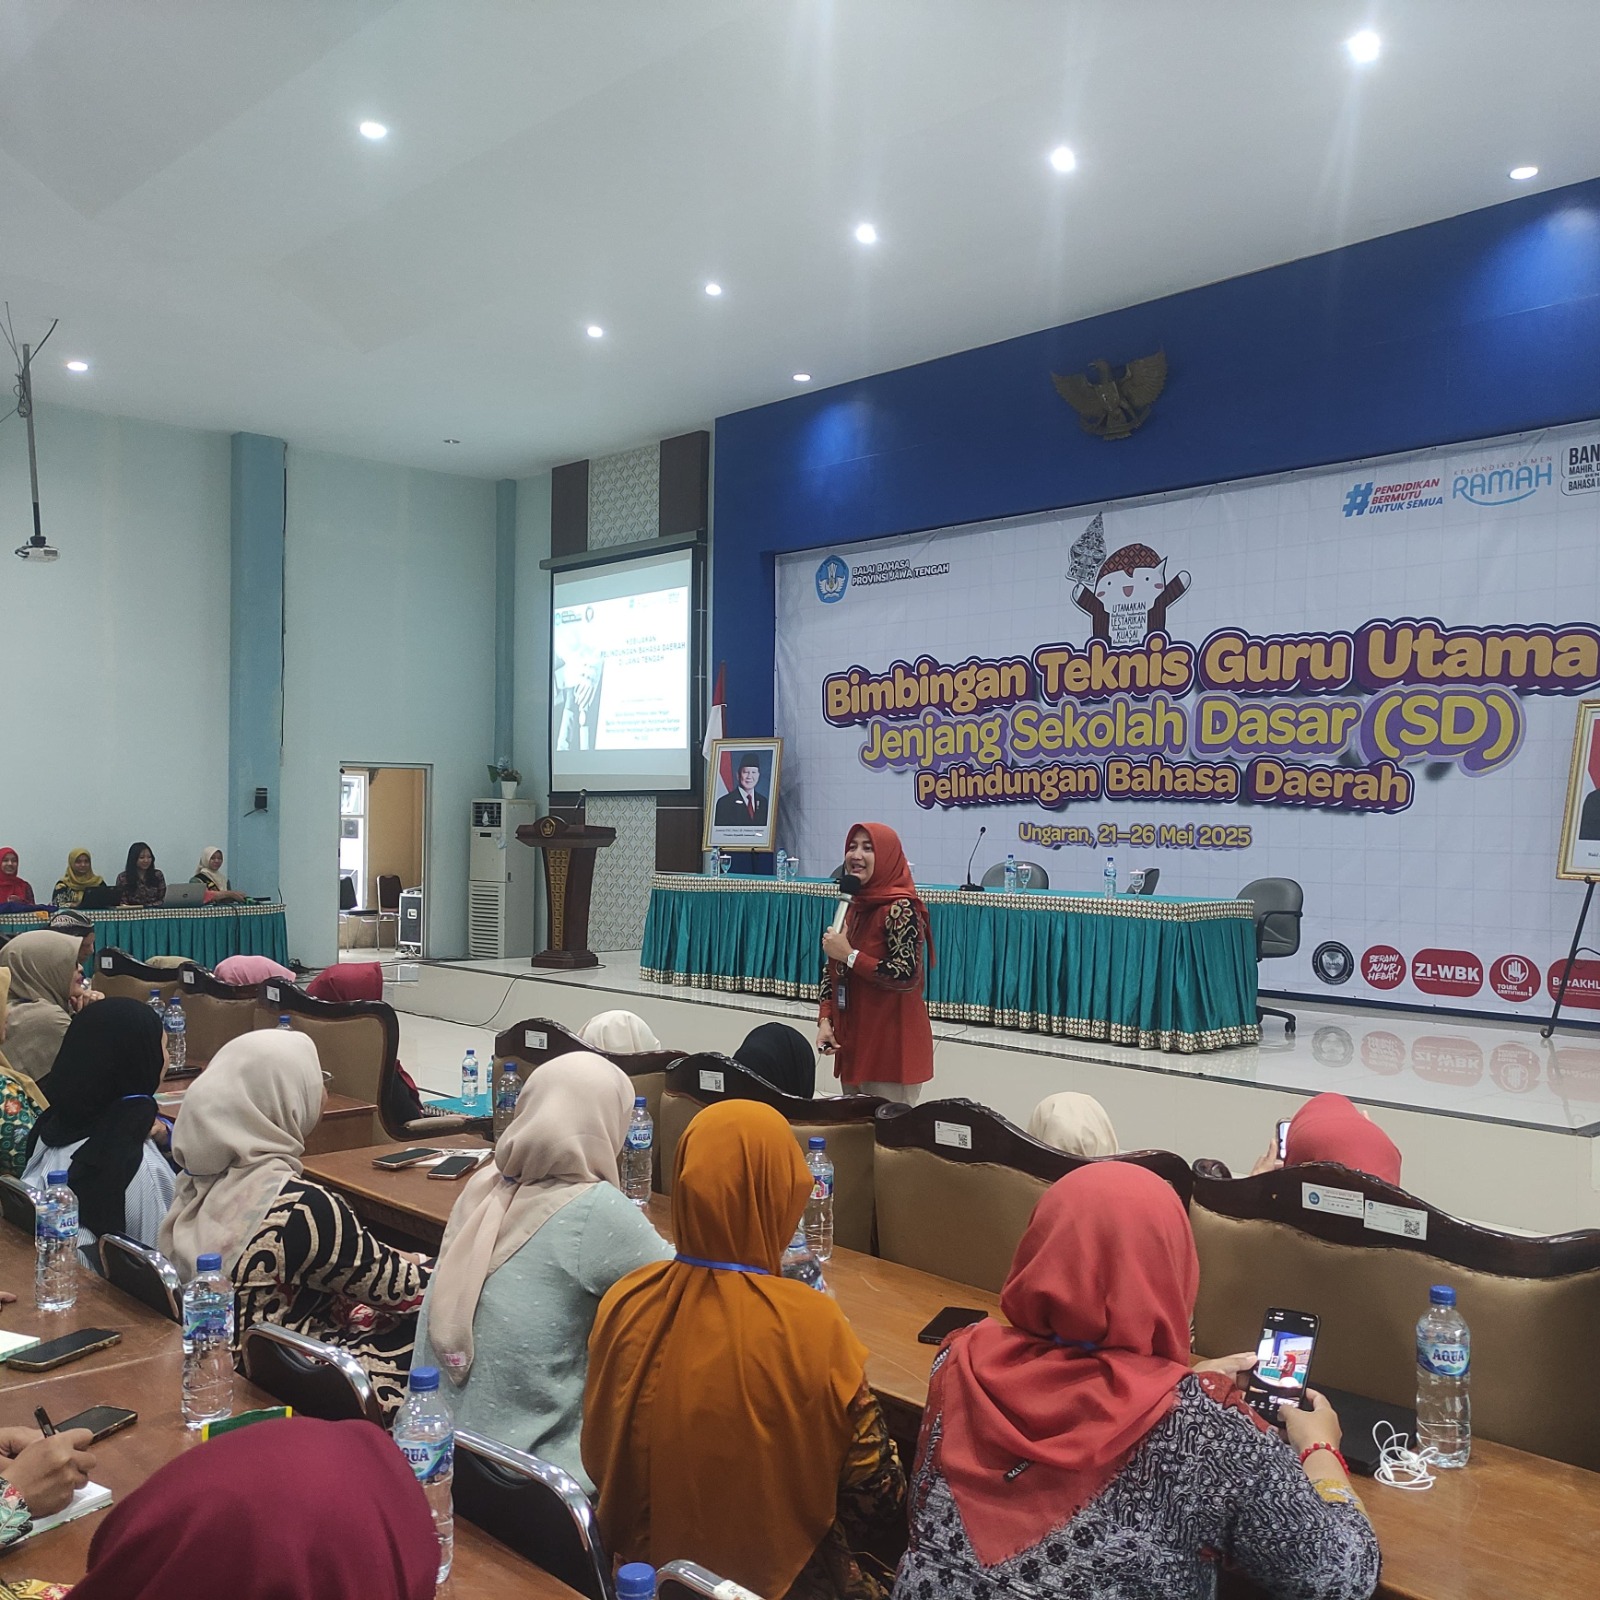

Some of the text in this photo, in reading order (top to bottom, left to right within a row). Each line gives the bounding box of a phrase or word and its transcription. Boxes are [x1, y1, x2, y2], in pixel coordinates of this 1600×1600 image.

[1374, 478, 1440, 495] PENDIDIKAN
[1452, 463, 1552, 505] RAMAH
[1569, 478, 1595, 491] BAHASA
[1368, 496, 1443, 514] UNTUK SEMUA
[1371, 490, 1422, 505] BERMUTU
[852, 559, 910, 576] BALAI BAHASA
[852, 563, 949, 586] PROVINSI JAWA TENGAH
[1112, 602, 1146, 613] UTAMAKAN
[1111, 616, 1146, 626] LESTARIKAN
[1116, 630, 1139, 639] KUASAI
[827, 628, 1599, 717] Bimbingan Teknis Guru Utama
[863, 694, 1515, 768] Jenjang Sekolah Dasar (SD)
[918, 759, 1407, 803] Pelindungan Bahasa Daerah
[1019, 822, 1094, 846] Ungaran,
[1159, 824, 1196, 845] Mei
[1199, 826, 1252, 847] 2025
[1369, 954, 1400, 963] BERANI
[1414, 962, 1481, 982] ZI-WBK
[1552, 976, 1600, 990] BrAKHL
[632, 1133, 652, 1142] AQUA
[60, 1216, 78, 1229] AQU
[1432, 1348, 1465, 1365] AQUA
[402, 1447, 430, 1465] QUA
